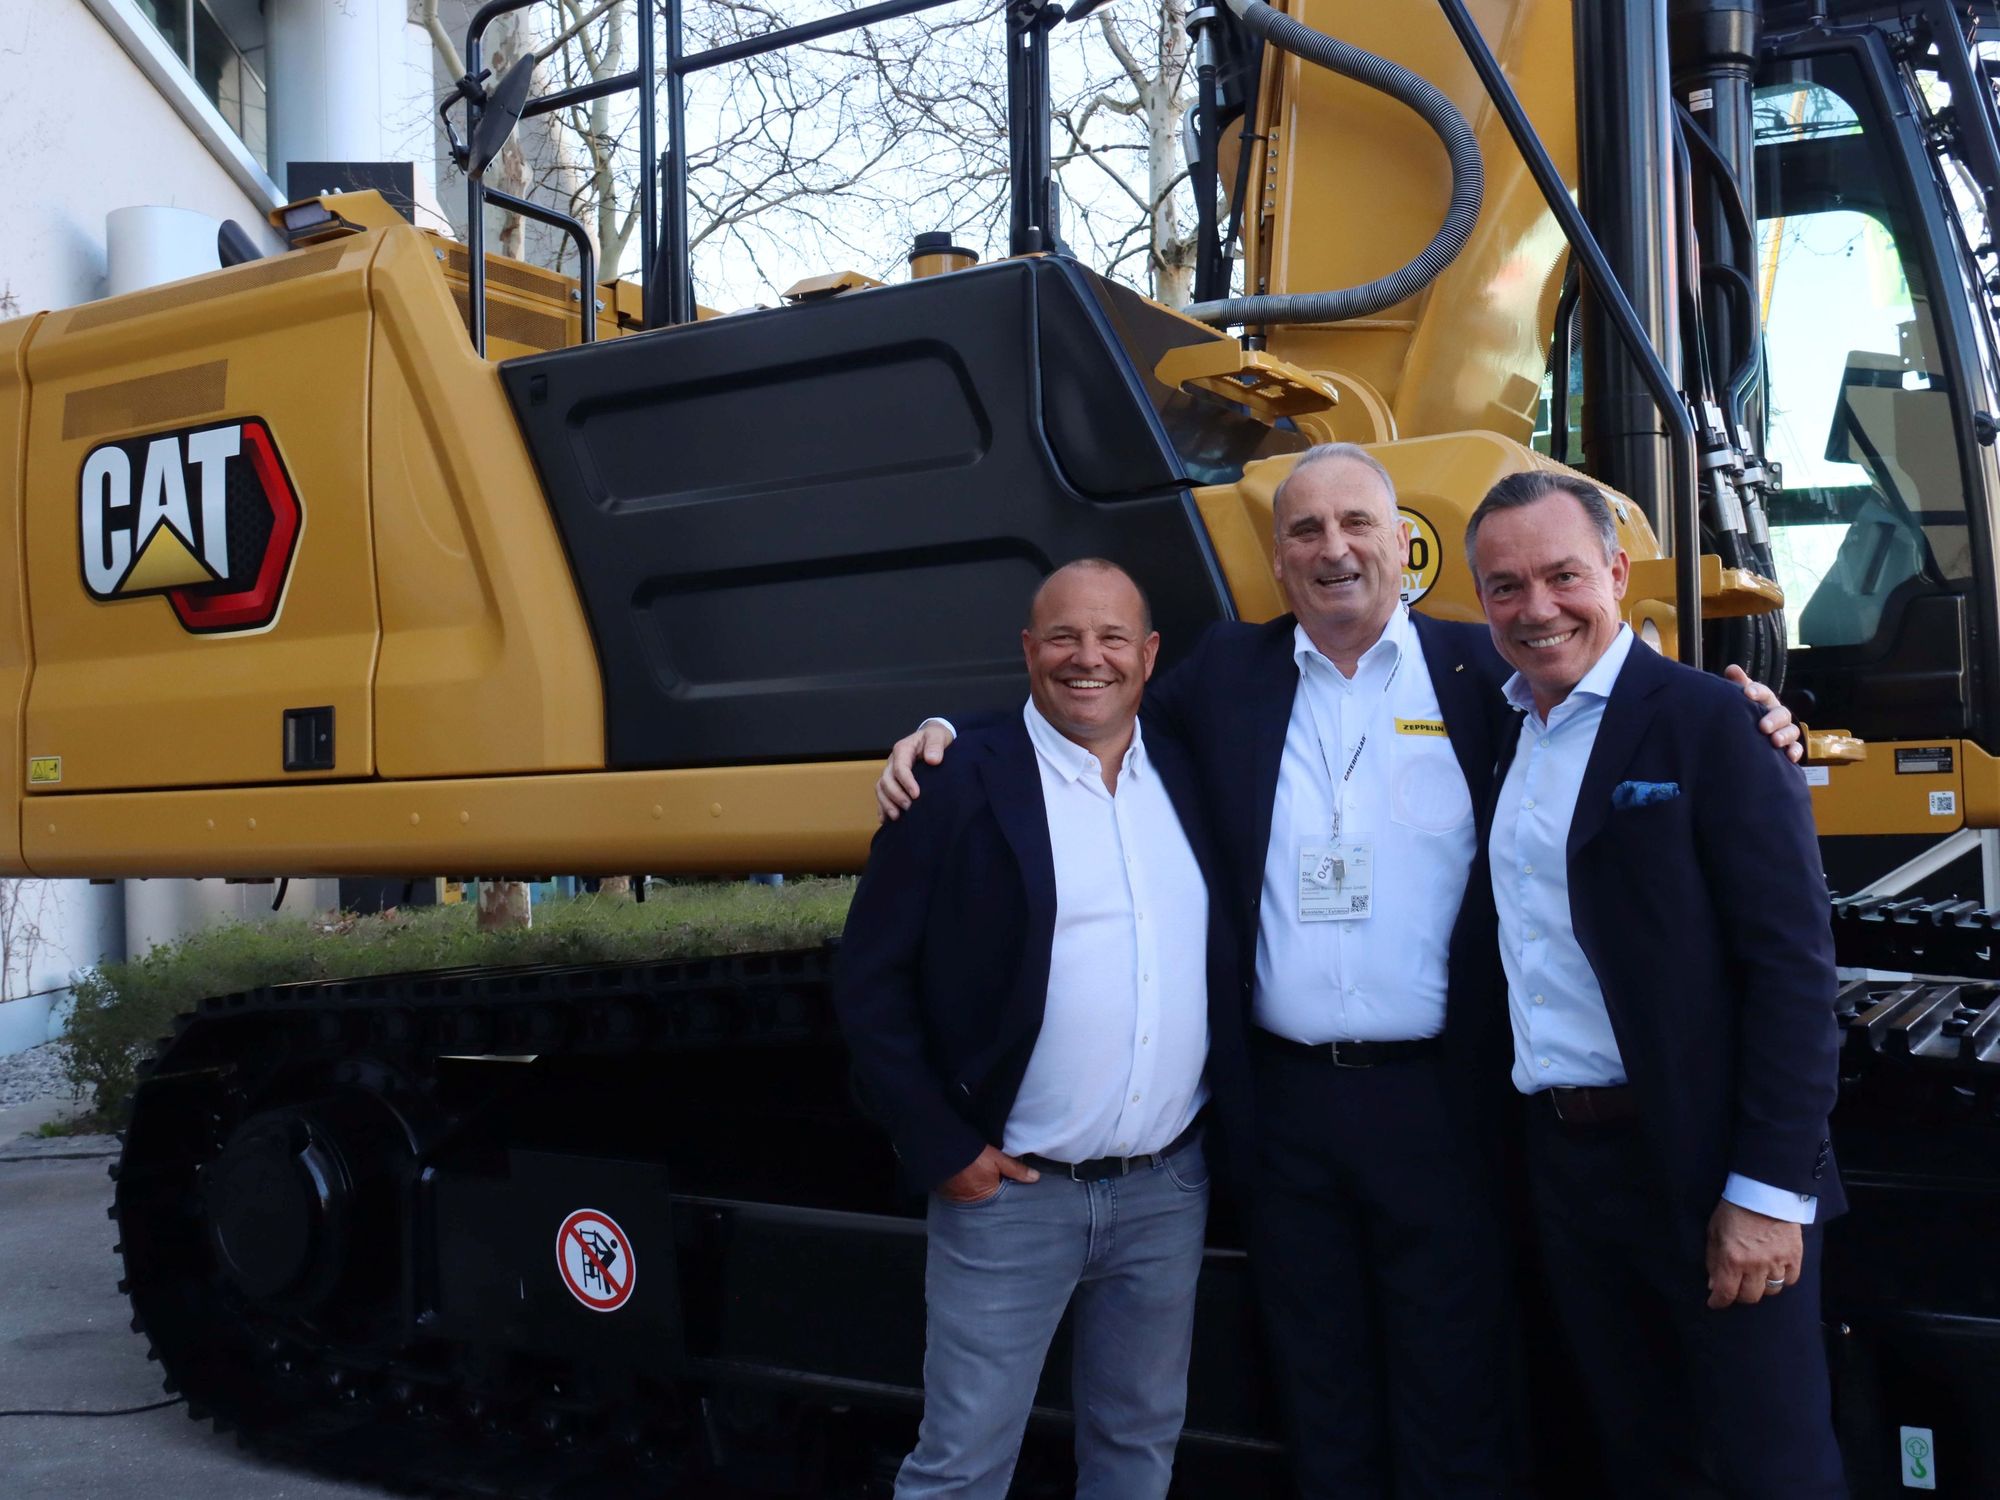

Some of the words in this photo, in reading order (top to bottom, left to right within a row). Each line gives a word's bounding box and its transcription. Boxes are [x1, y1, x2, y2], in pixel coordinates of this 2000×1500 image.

[82, 425, 241, 594] CAT
[1400, 573, 1423, 591] DY
[1403, 724, 1444, 732] ZEPPELIN
[1344, 736, 1366, 782] CATERPILLAR
[1317, 856, 1335, 880] 043
